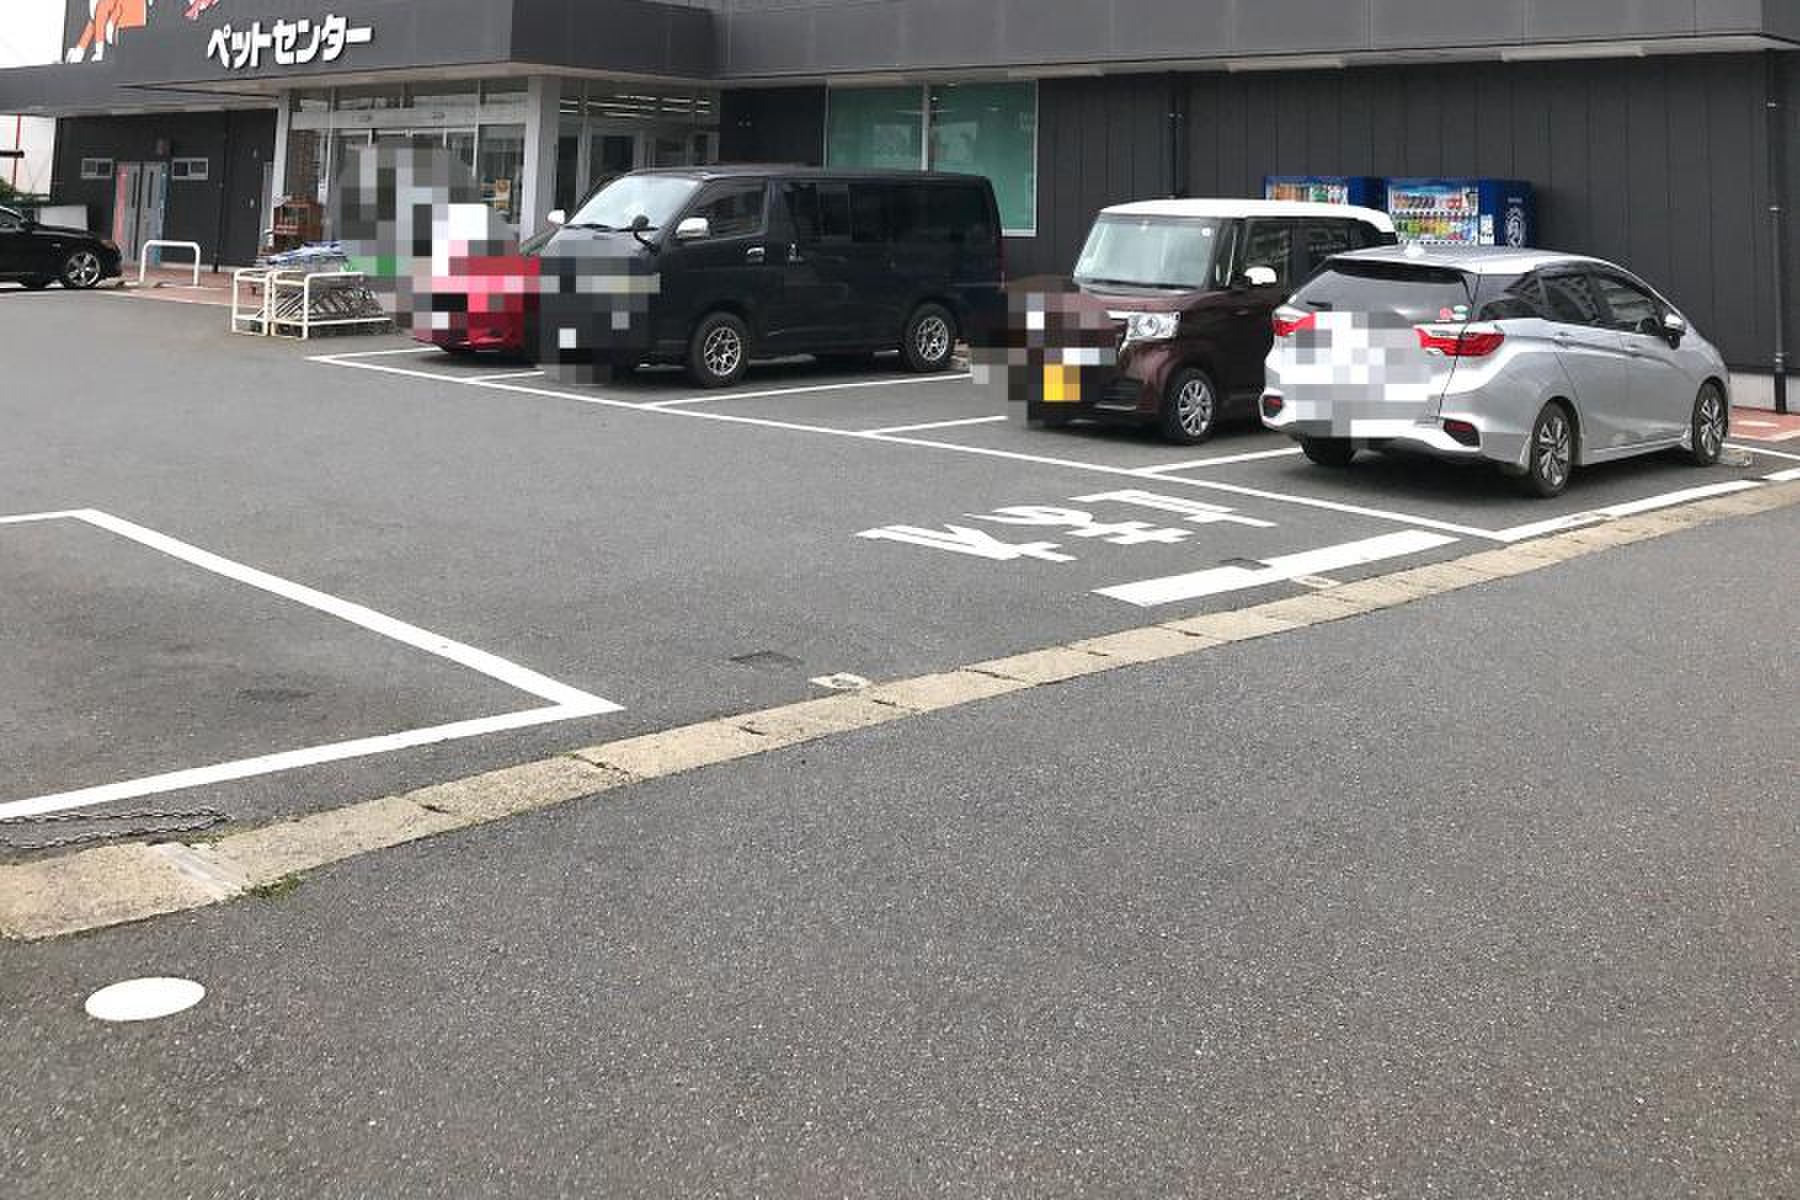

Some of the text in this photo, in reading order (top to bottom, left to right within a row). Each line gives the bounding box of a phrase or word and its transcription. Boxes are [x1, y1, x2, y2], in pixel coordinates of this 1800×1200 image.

[207, 13, 373, 70] ペットセンター
[854, 488, 1278, 563] 止まれ
